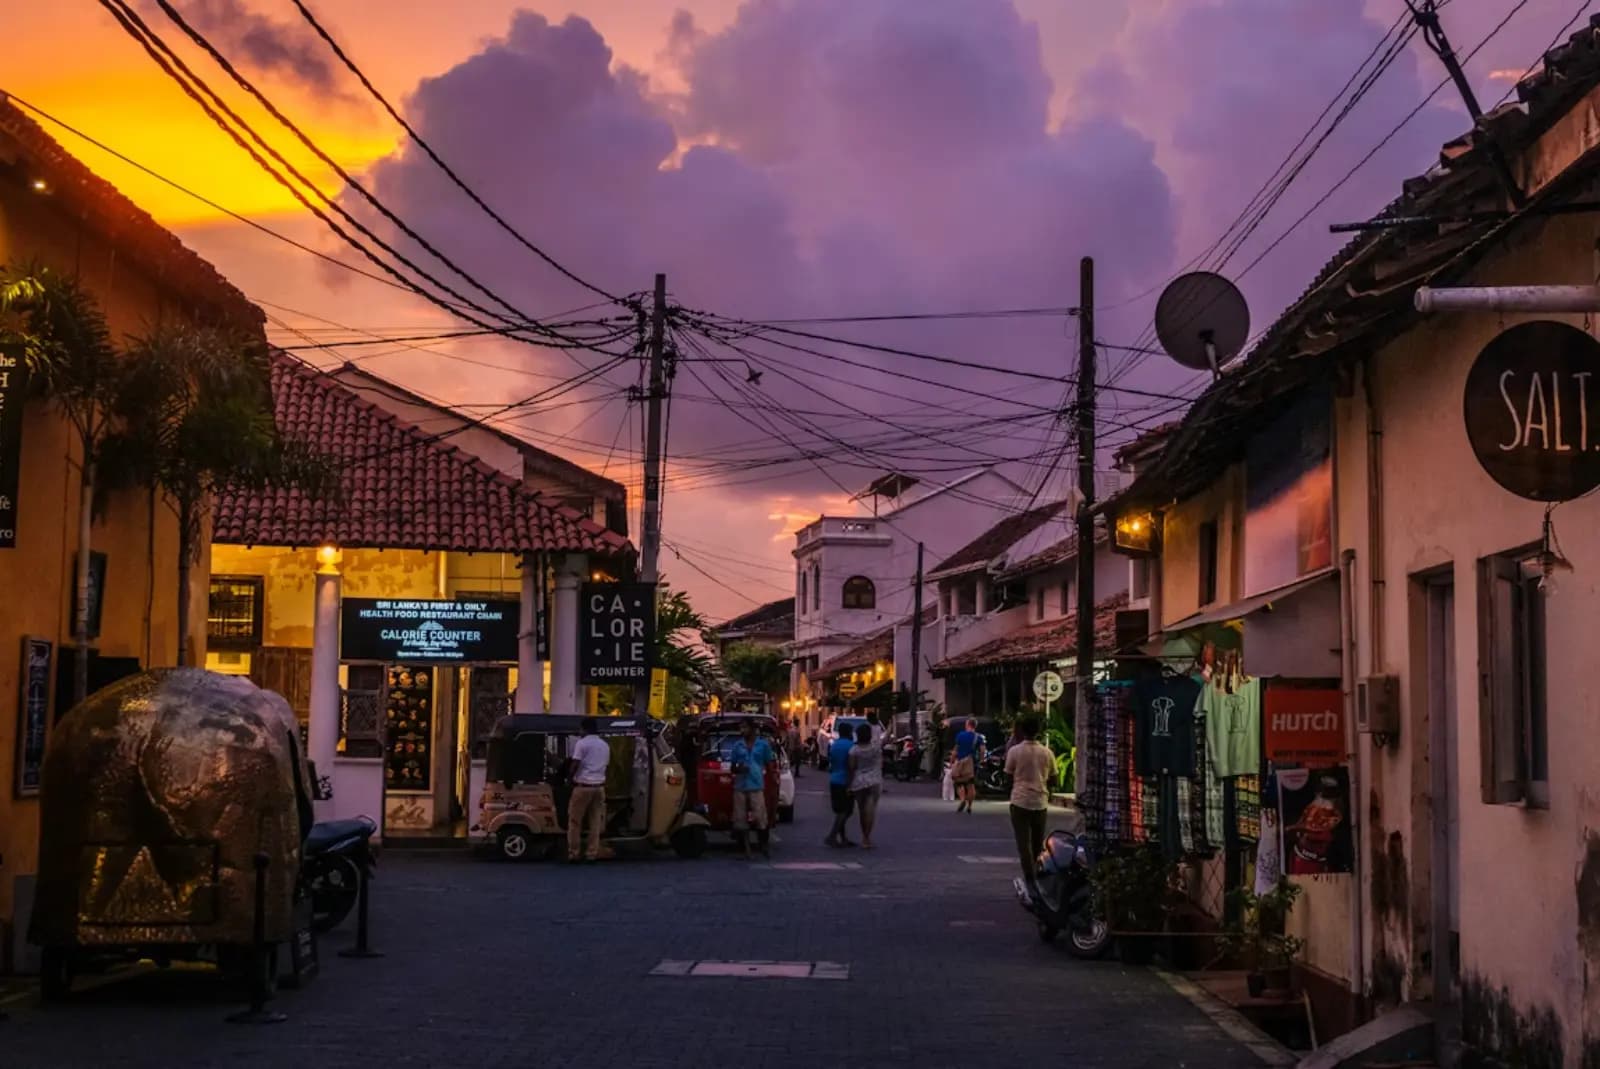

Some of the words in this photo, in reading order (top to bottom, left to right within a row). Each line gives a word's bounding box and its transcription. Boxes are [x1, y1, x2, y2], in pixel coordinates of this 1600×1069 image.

[376, 601, 391, 609] SRI
[393, 601, 429, 610] LANKA'S
[430, 602, 455, 610] FIRST
[464, 603, 487, 611] ONLY
[360, 609, 393, 618] HEALTH
[395, 610, 418, 618] FOOD
[420, 611, 475, 619] RESTAURANT
[476, 612, 502, 620] CHAIN
[591, 618, 644, 637] LOR
[381, 629, 427, 640] CALORIE
[430, 630, 481, 641] COUNTER
[590, 667, 645, 677] COUNTER
